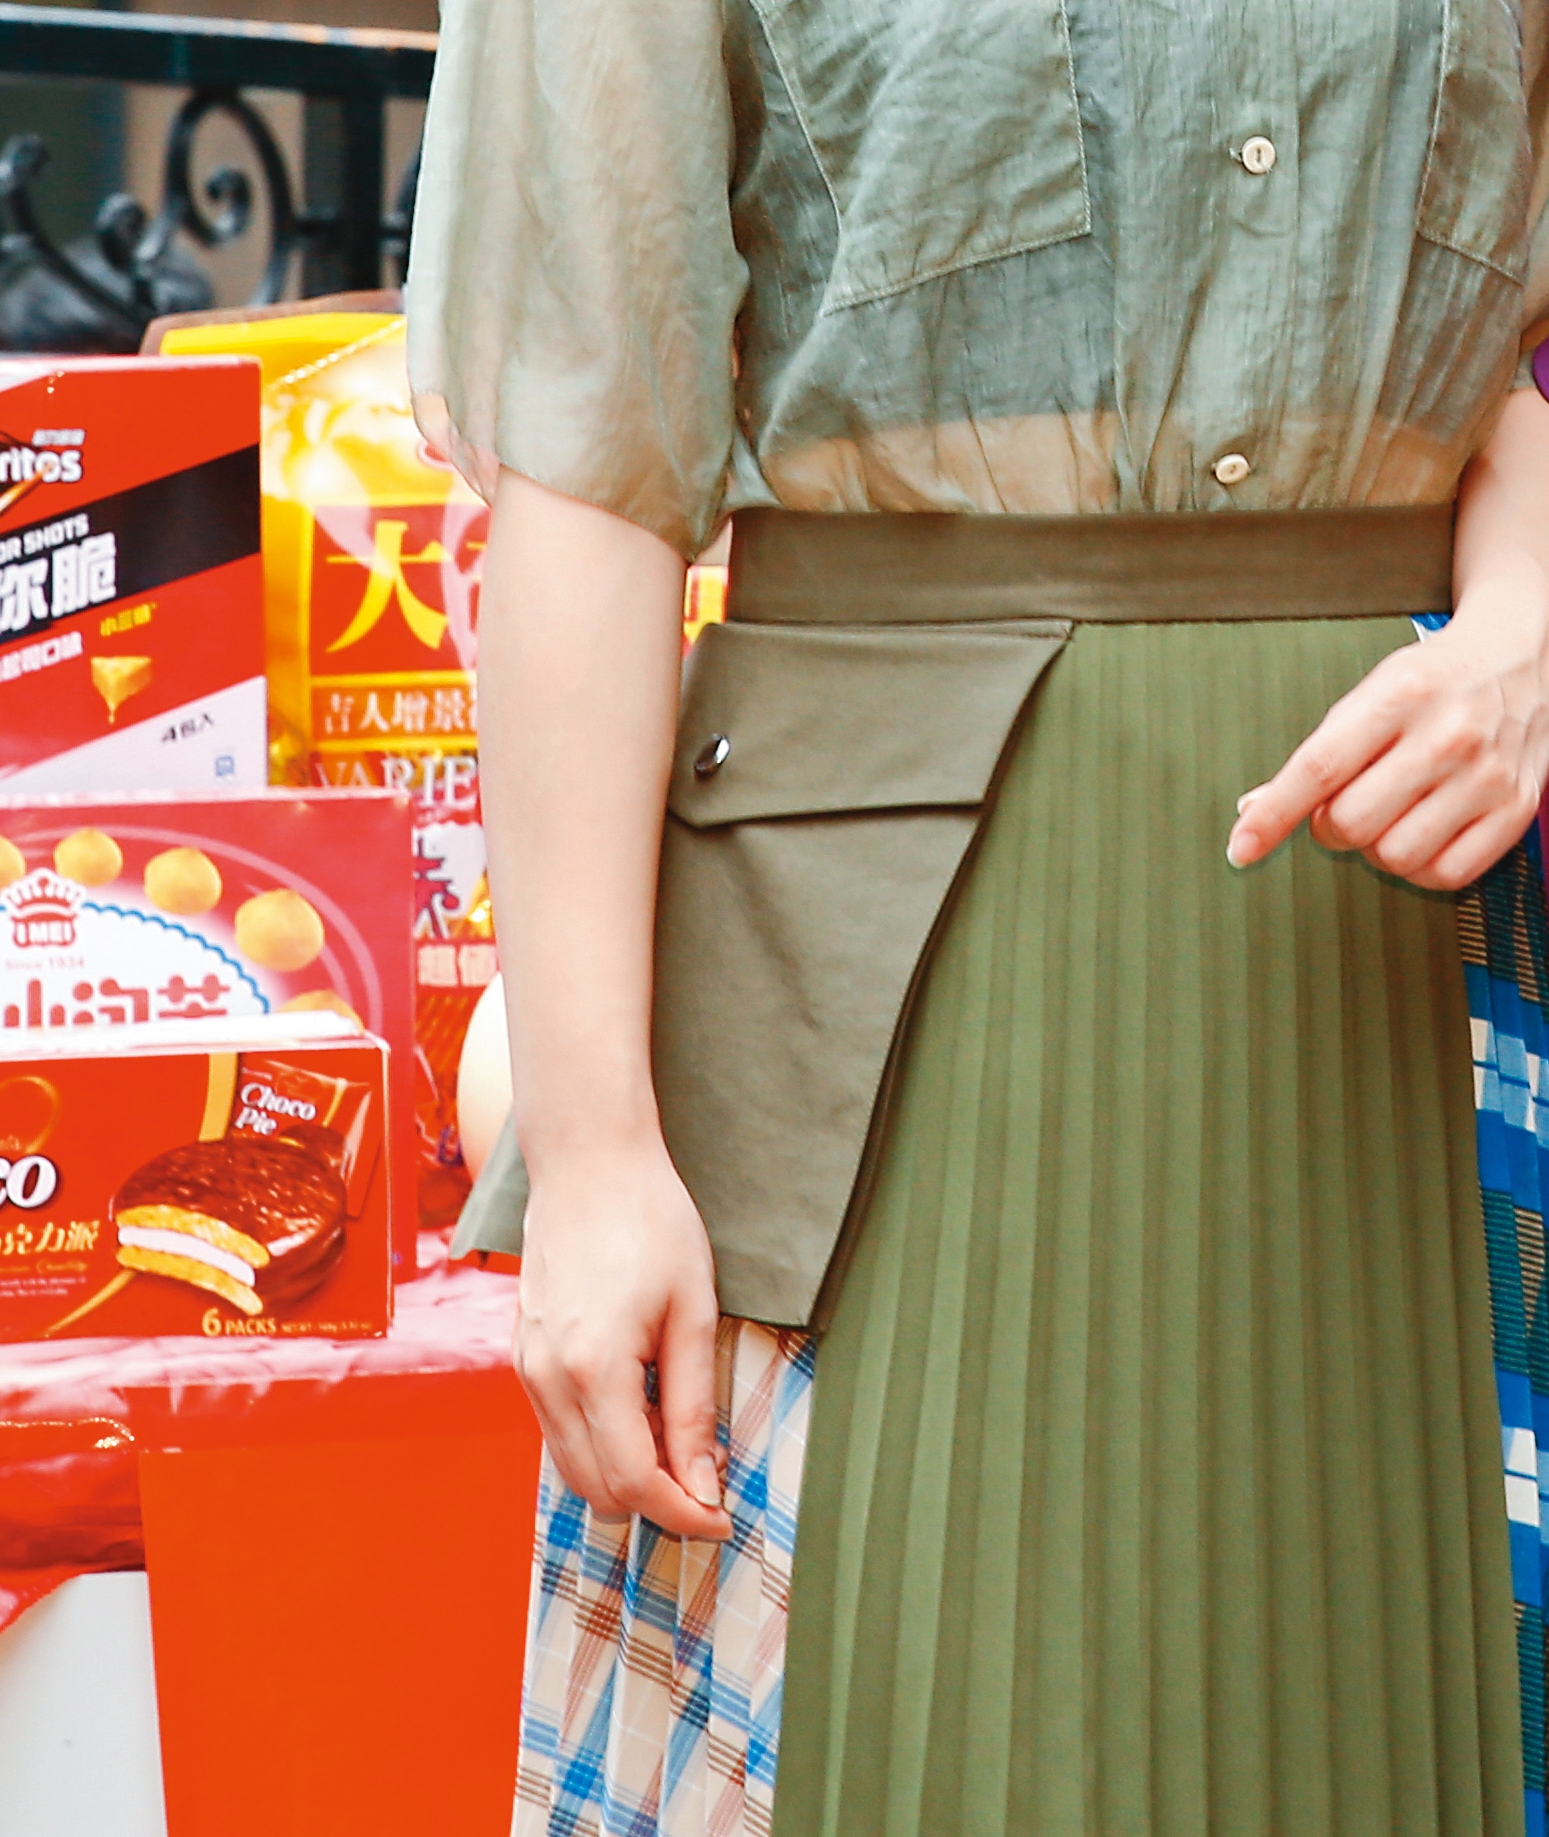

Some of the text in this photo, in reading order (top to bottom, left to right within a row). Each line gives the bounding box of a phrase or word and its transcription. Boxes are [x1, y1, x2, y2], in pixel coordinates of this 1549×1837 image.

[23, 513, 89, 556] SHOTS
[241, 1082, 317, 1121] Choco
[235, 1106, 277, 1136] Pie
[202, 1307, 222, 1337] 6
[225, 1318, 277, 1335] PACKS
